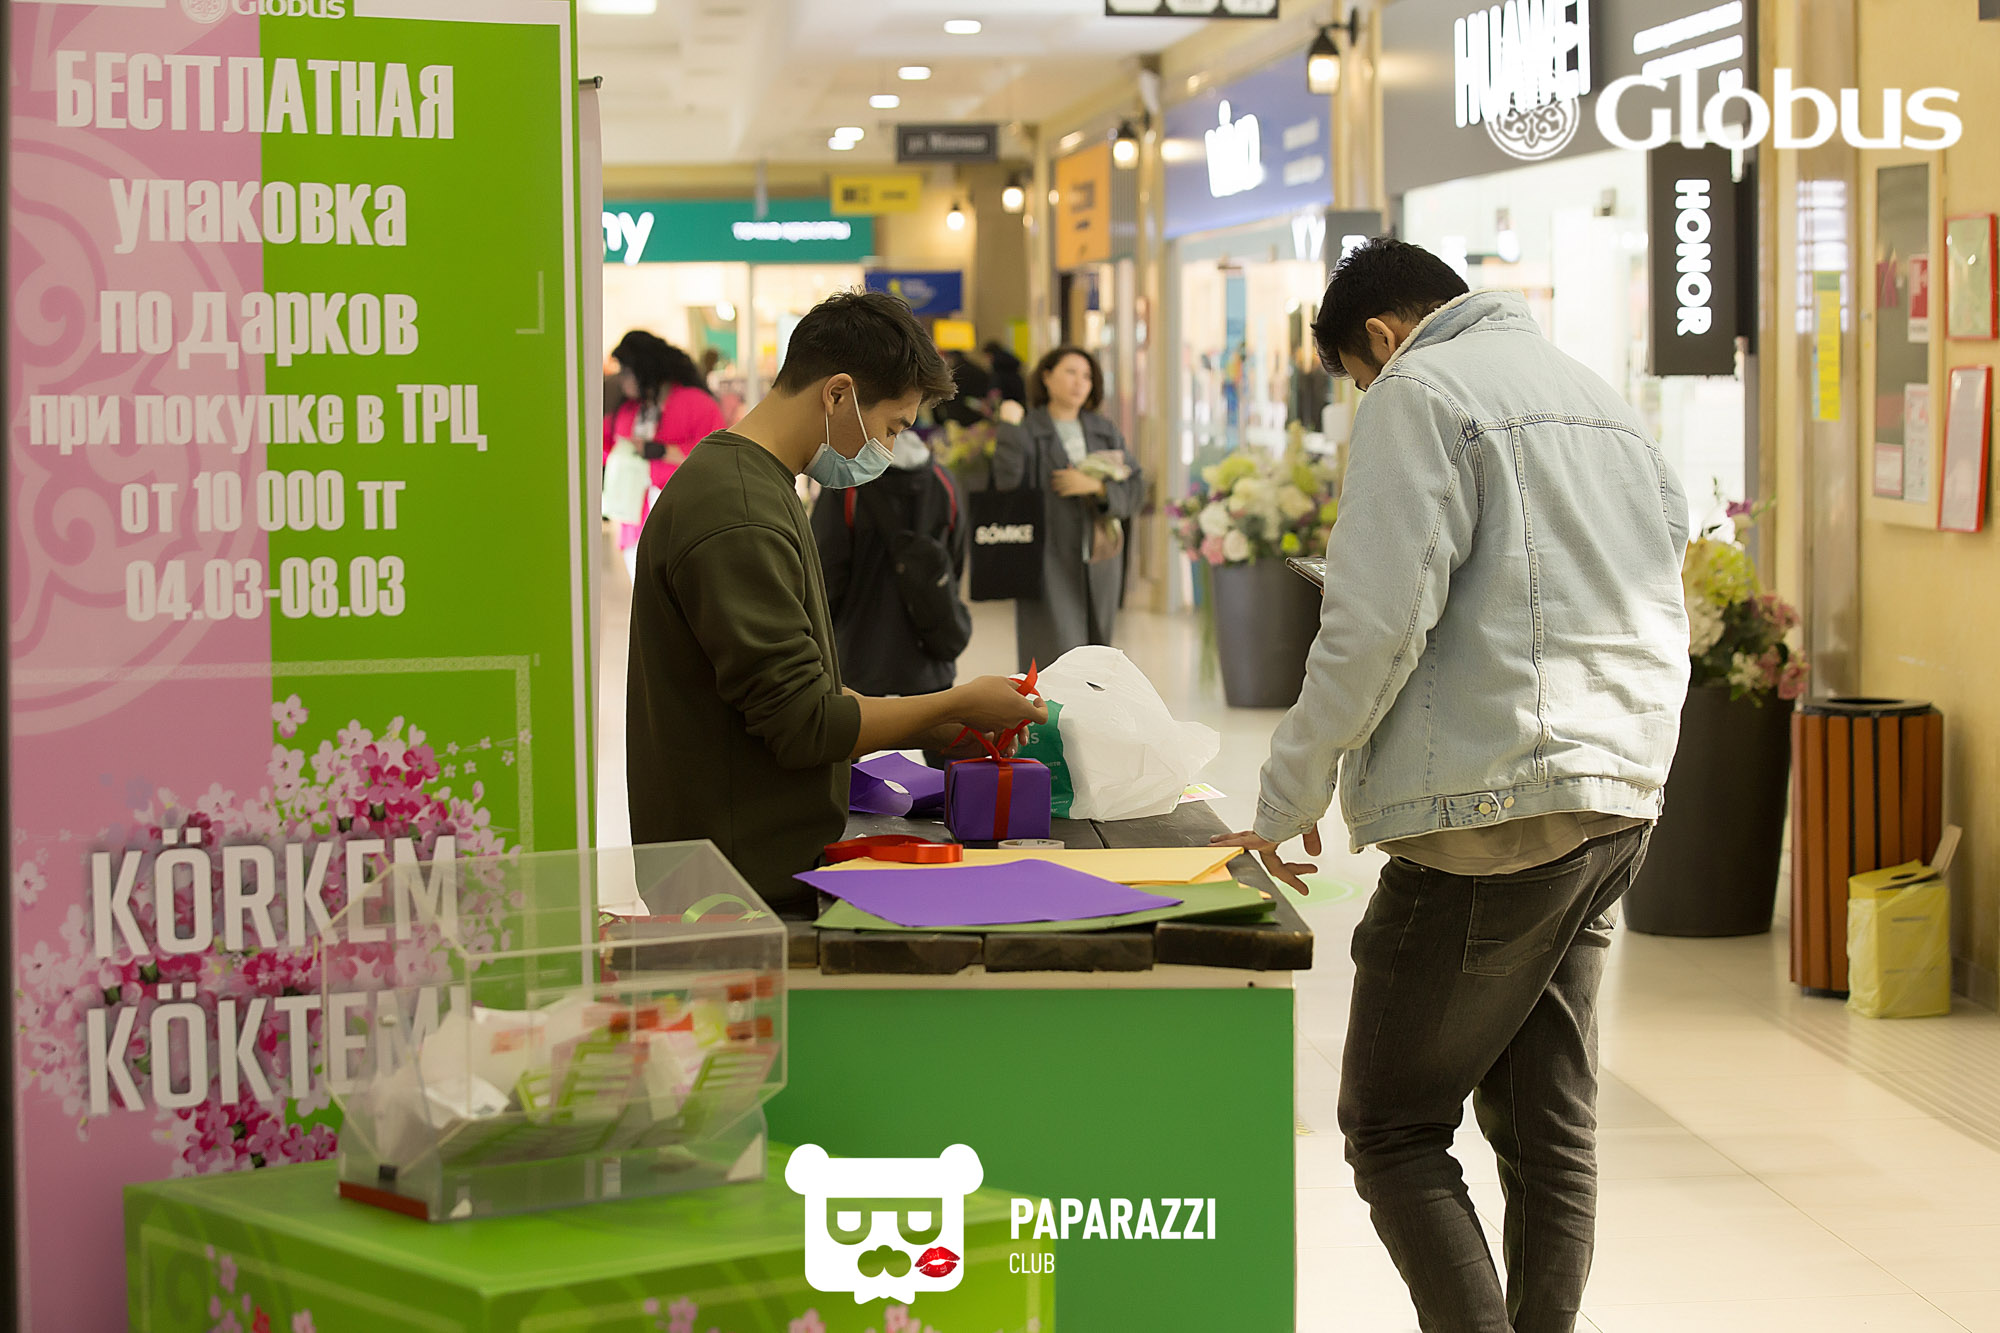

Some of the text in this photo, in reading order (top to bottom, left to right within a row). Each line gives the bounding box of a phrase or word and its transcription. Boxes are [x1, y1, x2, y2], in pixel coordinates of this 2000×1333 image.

[55, 50, 455, 139] БЕСПЛАТНАЯ
[1454, 0, 1591, 128] HUAWEI
[109, 178, 407, 254] упаковка
[1675, 178, 1712, 337] HONOR
[29, 384, 488, 454] при покупке в ТРЦ
[120, 469, 406, 533] от 10 000 тг
[125, 555, 406, 621] 04.03-08.03
[91, 827, 459, 958] KÖRKEM
